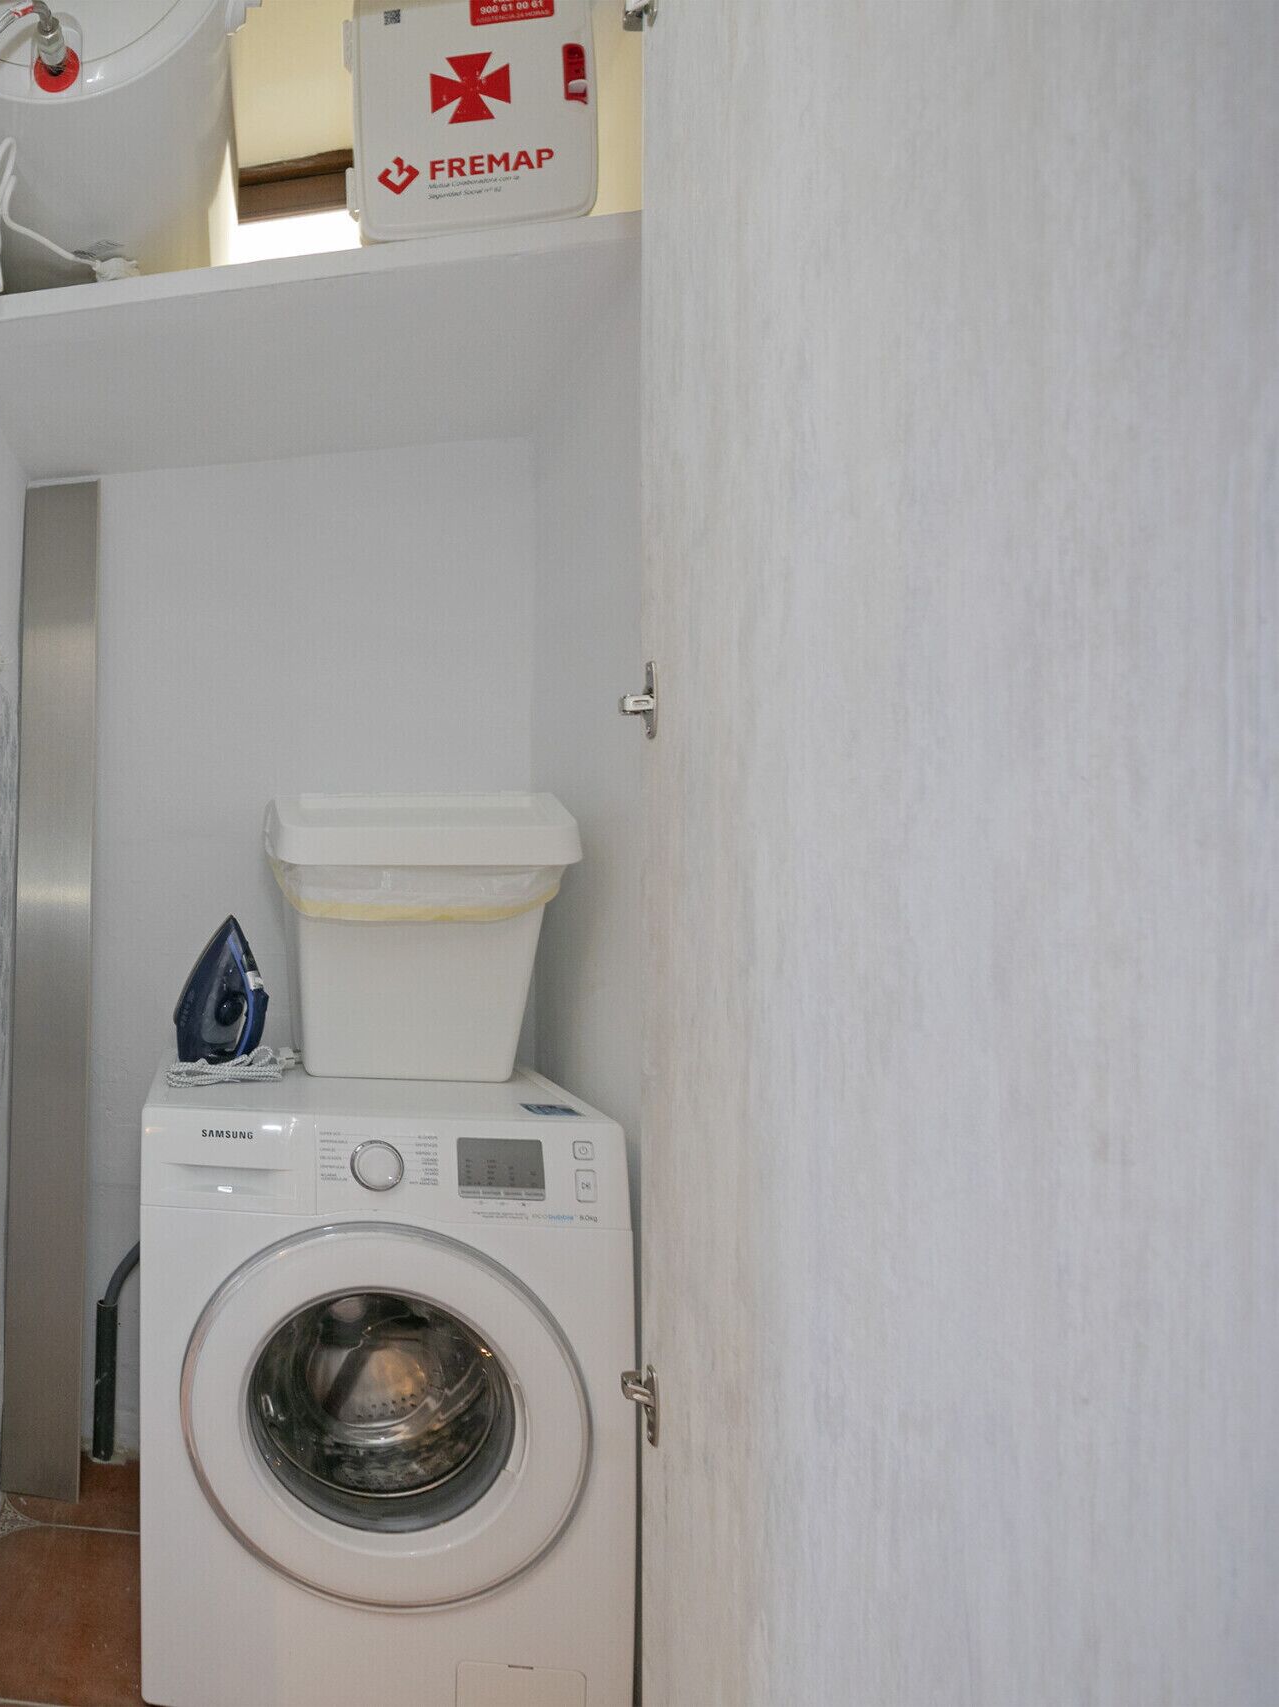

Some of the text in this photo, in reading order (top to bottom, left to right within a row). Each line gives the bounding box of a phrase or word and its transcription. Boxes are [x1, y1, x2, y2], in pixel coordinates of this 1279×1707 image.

[480, 5, 499, 15] 900
[501, 4, 513, 12] 61
[516, 1, 529, 10] 00
[429, 148, 554, 181] FREMAP
[201, 1128, 254, 1140] SAMSUNG
